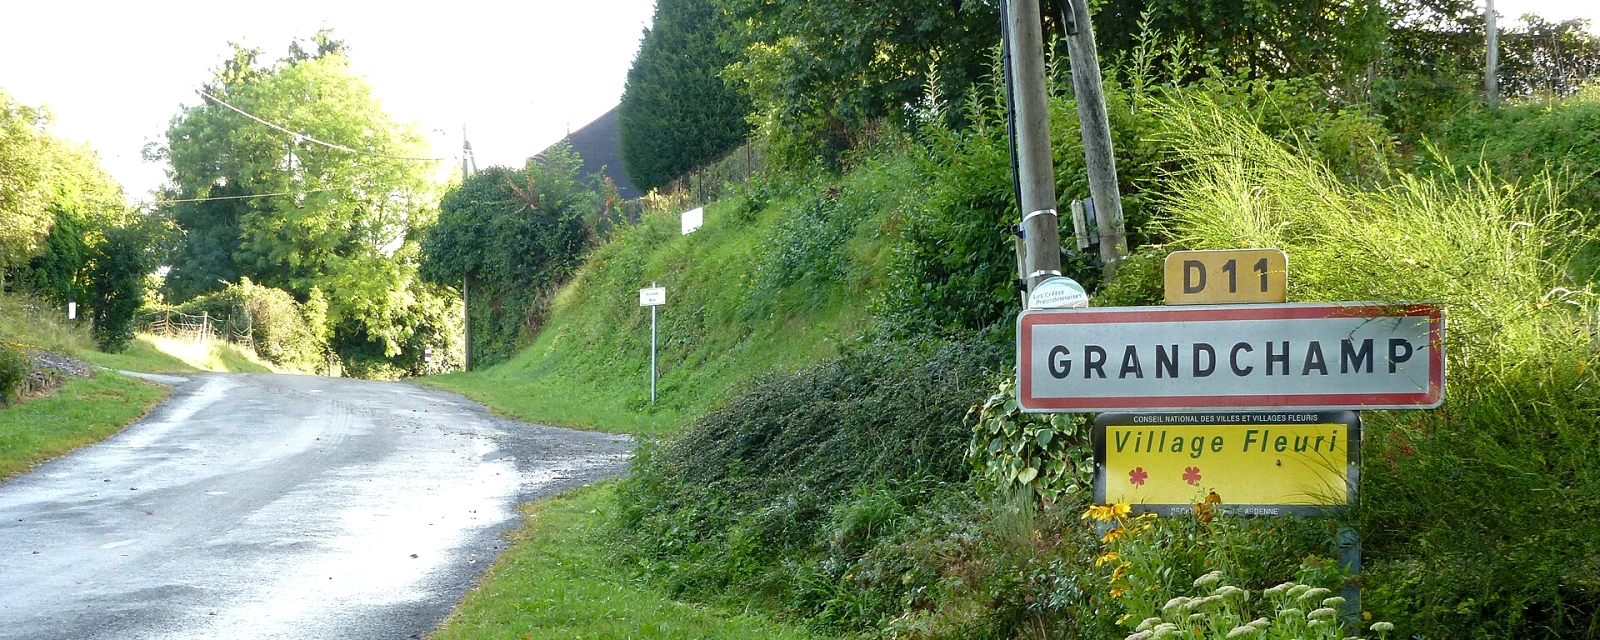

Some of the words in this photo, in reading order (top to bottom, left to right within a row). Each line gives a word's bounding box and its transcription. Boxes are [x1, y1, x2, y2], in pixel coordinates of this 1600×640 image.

[1035, 293, 1082, 305] Préardennaises
[1045, 290, 1065, 298] Crêtes
[1047, 338, 1415, 380] GRANDCHAMP
[1133, 415, 1164, 423] CONSEIL
[1165, 415, 1199, 423] NATIONAL
[1252, 414, 1287, 422] VILLAGES
[1288, 414, 1319, 422] FLEURIS
[1114, 430, 1225, 459] Village
[1242, 429, 1338, 453] Fleuri
